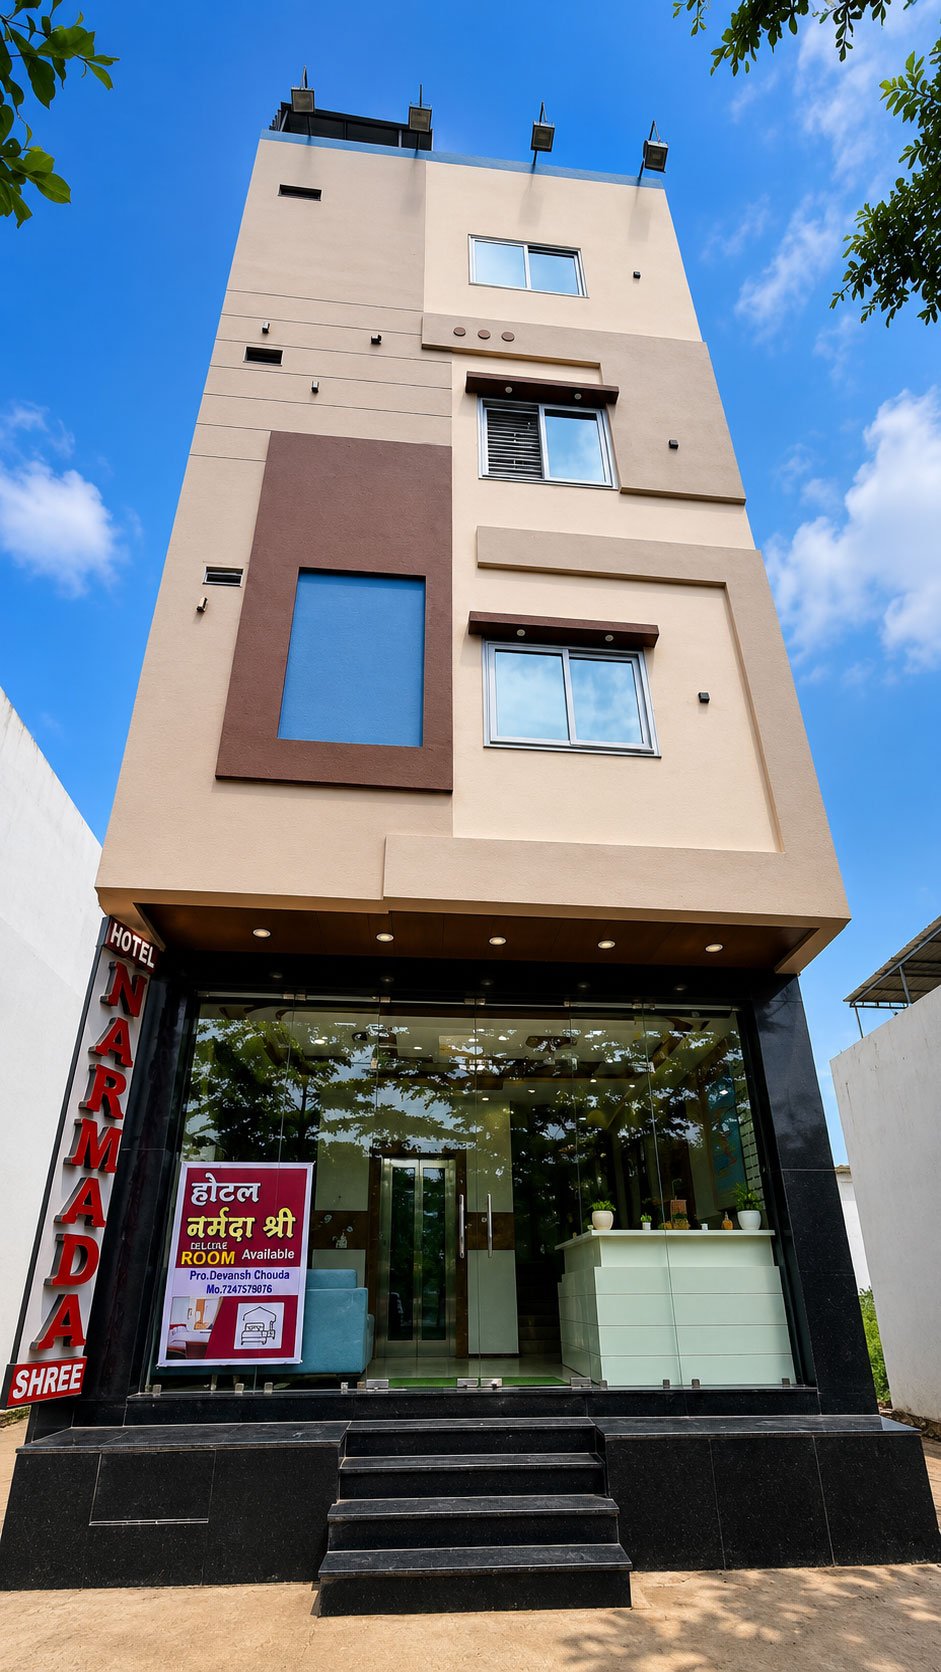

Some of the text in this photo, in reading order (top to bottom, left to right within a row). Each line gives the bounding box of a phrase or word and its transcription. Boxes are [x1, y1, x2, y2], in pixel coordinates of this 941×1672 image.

[110, 922, 155, 969] HOTEL
[31, 960, 148, 1351] NARMADA
[191, 1172, 261, 1206] होटल
[186, 1206, 296, 1242] नर्मदा श्री
[181, 1248, 295, 1265] ROOM Available
[189, 1269, 251, 1281] Pro.Devansh
[12, 1363, 84, 1400] SHREE
